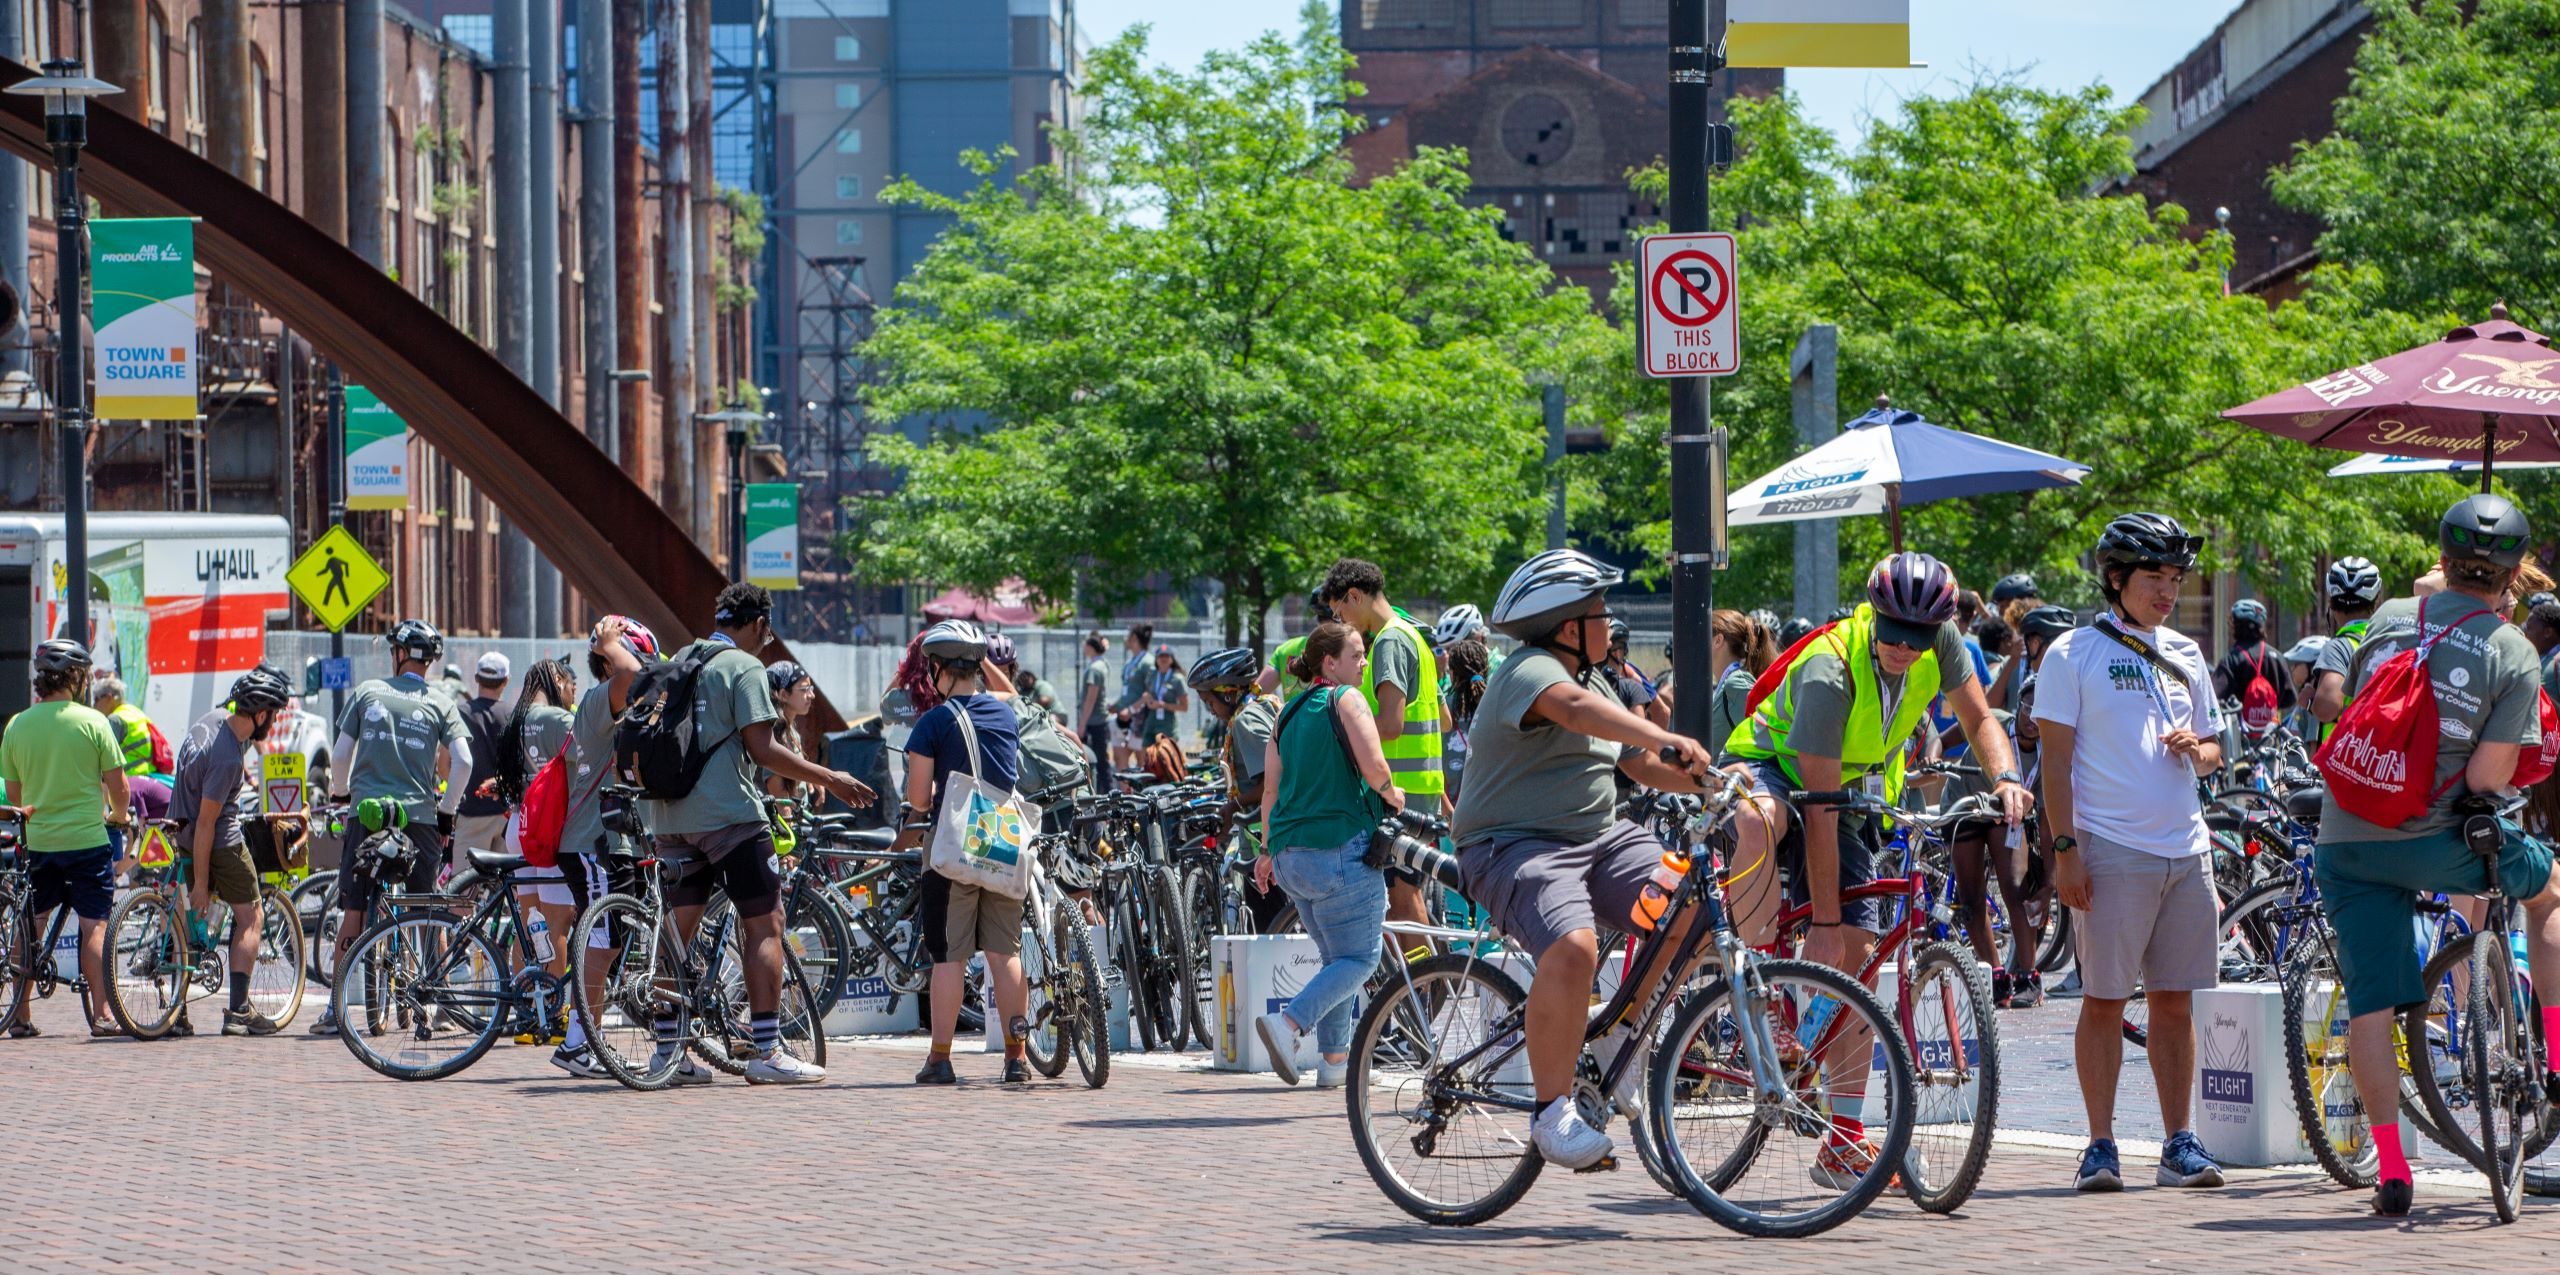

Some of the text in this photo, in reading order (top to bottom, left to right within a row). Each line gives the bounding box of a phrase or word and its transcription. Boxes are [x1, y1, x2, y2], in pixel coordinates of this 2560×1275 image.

[139, 244, 158, 253] AIR
[101, 253, 158, 263] PRODUCTS
[1674, 329, 1711, 347] THIS
[105, 347, 165, 362] TOWN
[1666, 352, 1720, 370] BLOCK
[105, 364, 186, 380] SQUARE
[353, 465, 389, 475] TOWN
[353, 475, 401, 486] SQUARE
[1775, 474, 1854, 494] FLIGHT
[196, 548, 259, 582] U-HAUL
[2386, 615, 2415, 627] Youth
[2450, 626, 2472, 641] The
[2122, 635, 2147, 655] Nikon
[2472, 647, 2482, 657] PA
[2110, 657, 2133, 665] BANK
[2445, 693, 2479, 714] Council
[2460, 690, 2482, 705] Youth
[270, 756, 298, 766] STE
[274, 767, 293, 776] LAW
[1290, 953, 1324, 967] Yuengli
[845, 980, 892, 996] LIGH
[853, 997, 889, 1007] GENERAT
[1630, 968, 1675, 1042] GIANT
[2208, 1076, 2246, 1097] FLIGHT
[2205, 1102, 2251, 1114] NEXT GENERATION
[2327, 1106, 2354, 1115] FLGH
[2209, 1113, 2247, 1124] OF LIGHT BEER
